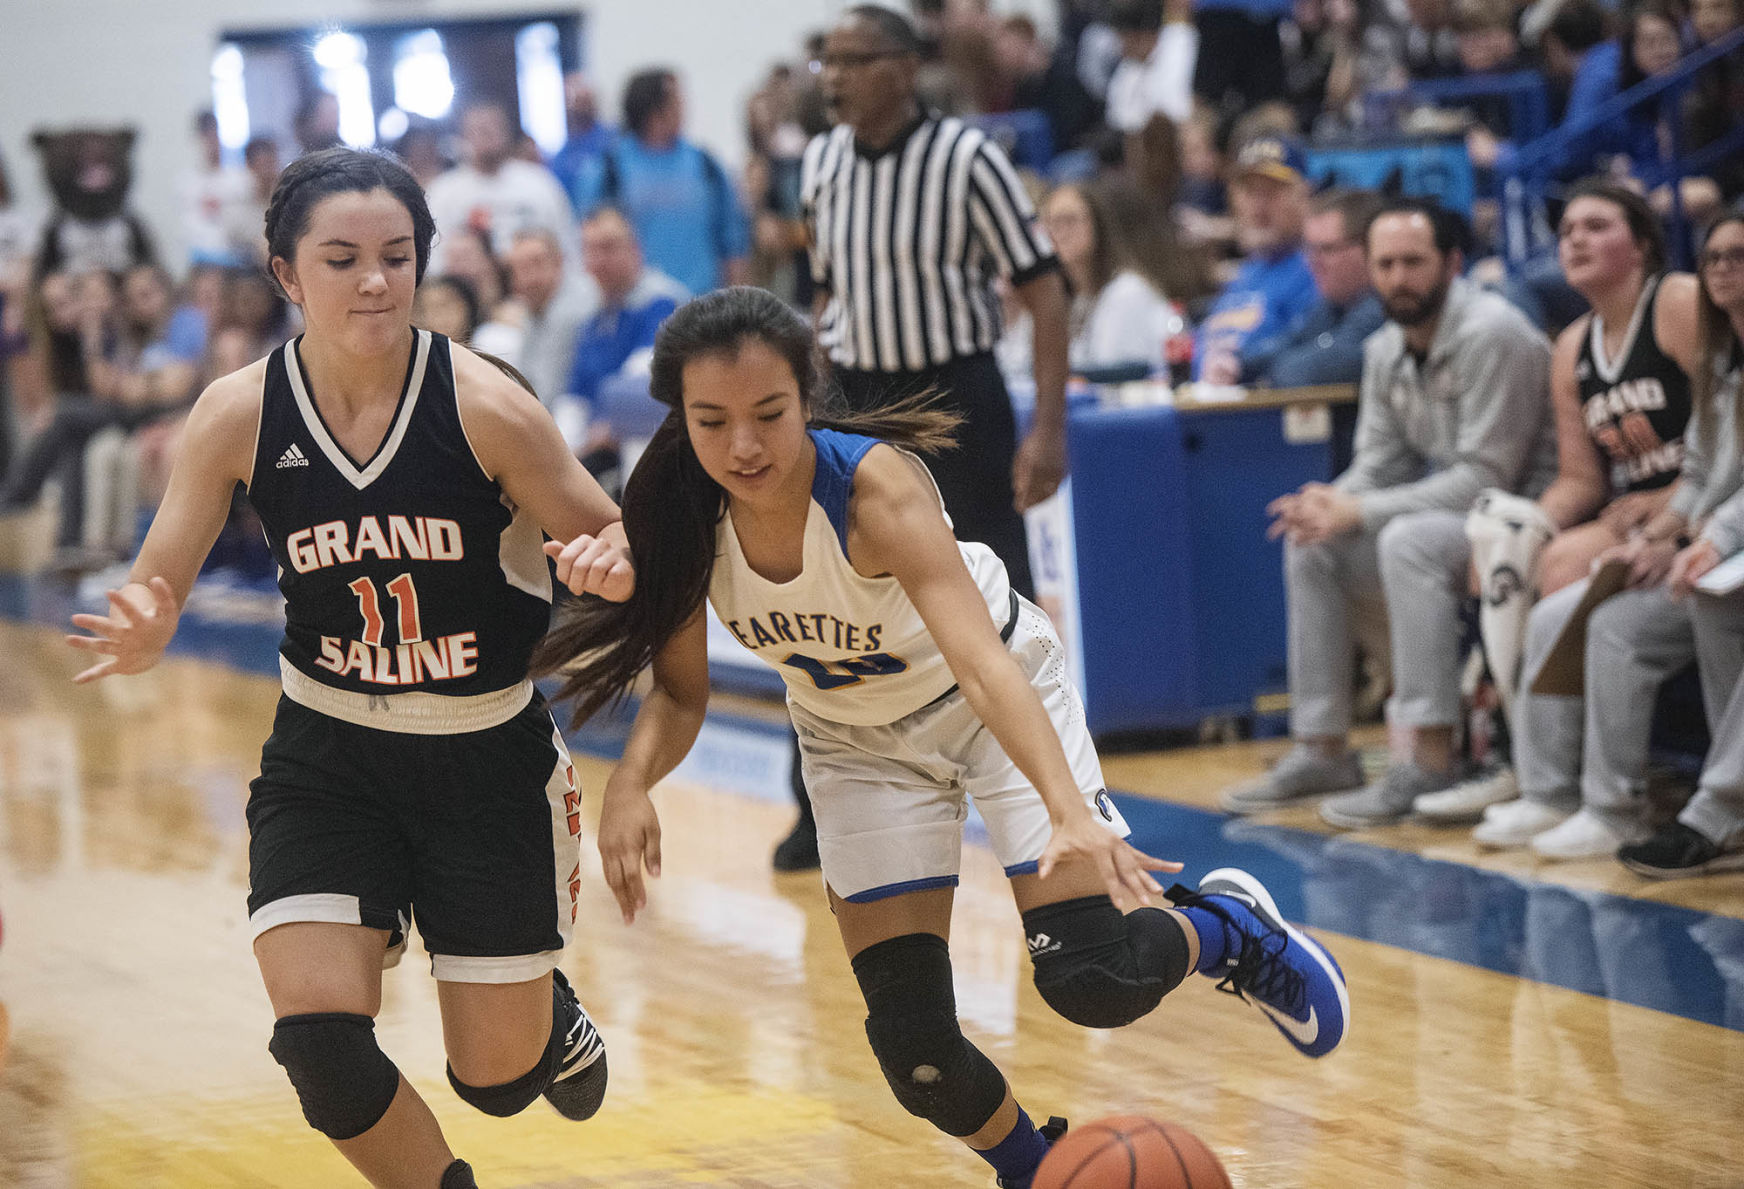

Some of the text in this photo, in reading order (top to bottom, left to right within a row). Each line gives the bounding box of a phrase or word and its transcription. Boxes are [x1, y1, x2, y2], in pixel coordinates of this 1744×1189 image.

[275, 458, 309, 469] adidas
[286, 515, 465, 575] GRAND
[347, 572, 423, 647] 11
[313, 631, 479, 686] SALINE
